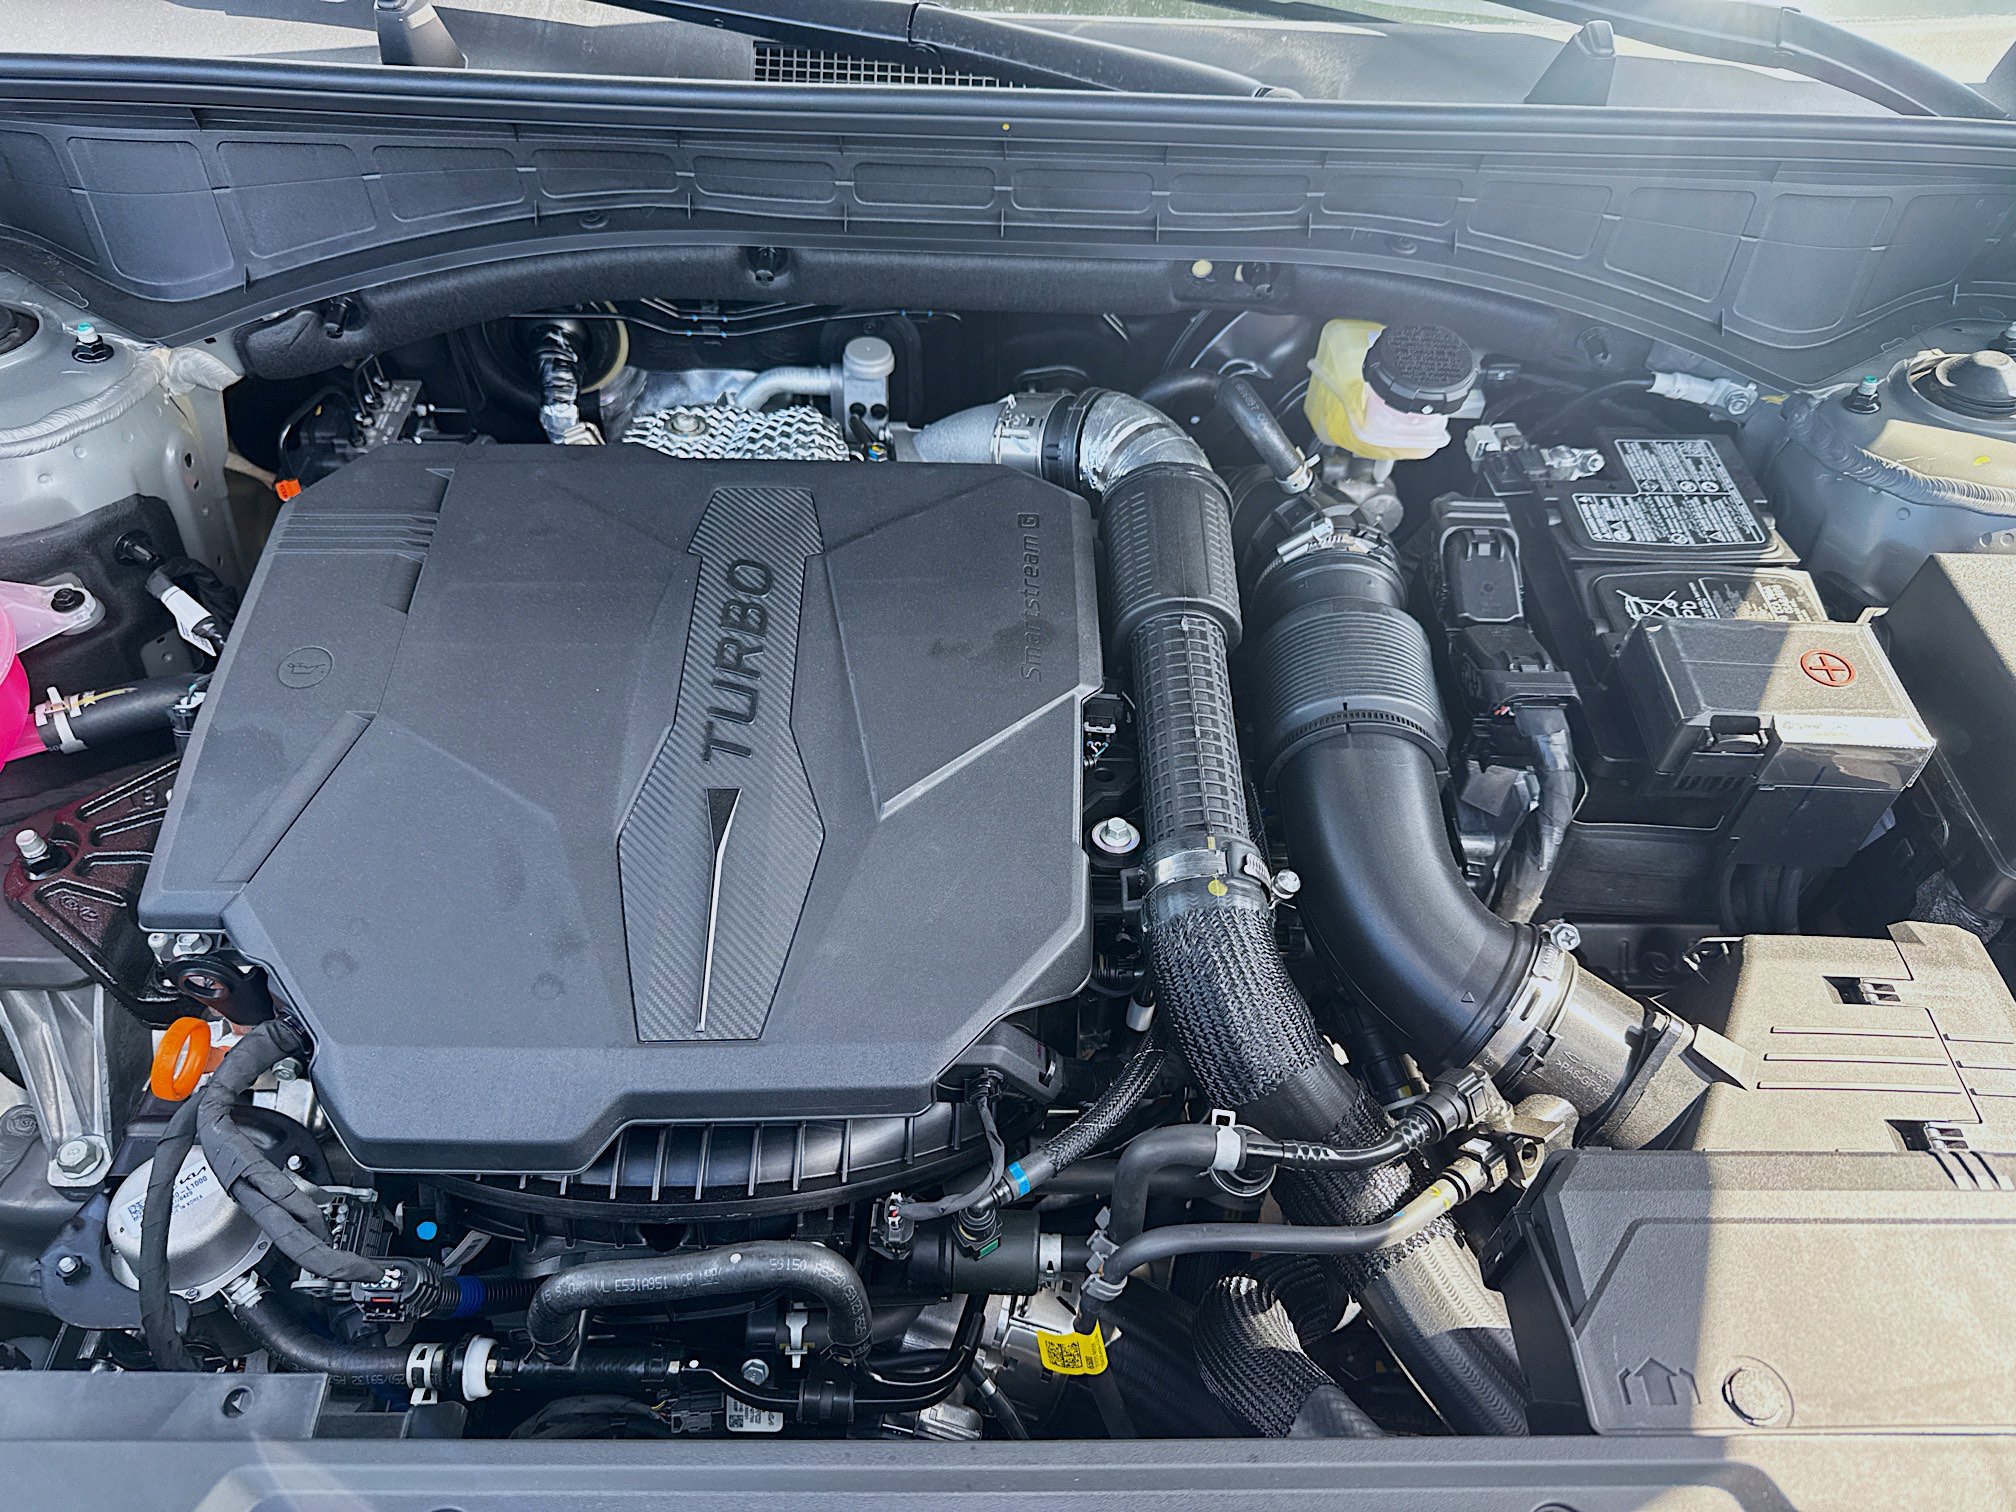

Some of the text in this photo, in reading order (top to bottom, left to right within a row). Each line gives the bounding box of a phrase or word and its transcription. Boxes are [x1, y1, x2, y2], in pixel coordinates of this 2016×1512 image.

[702, 558, 773, 765] TURBO
[1017, 512, 1042, 683] Smartstream G
[769, 1258, 808, 1272] 59150
